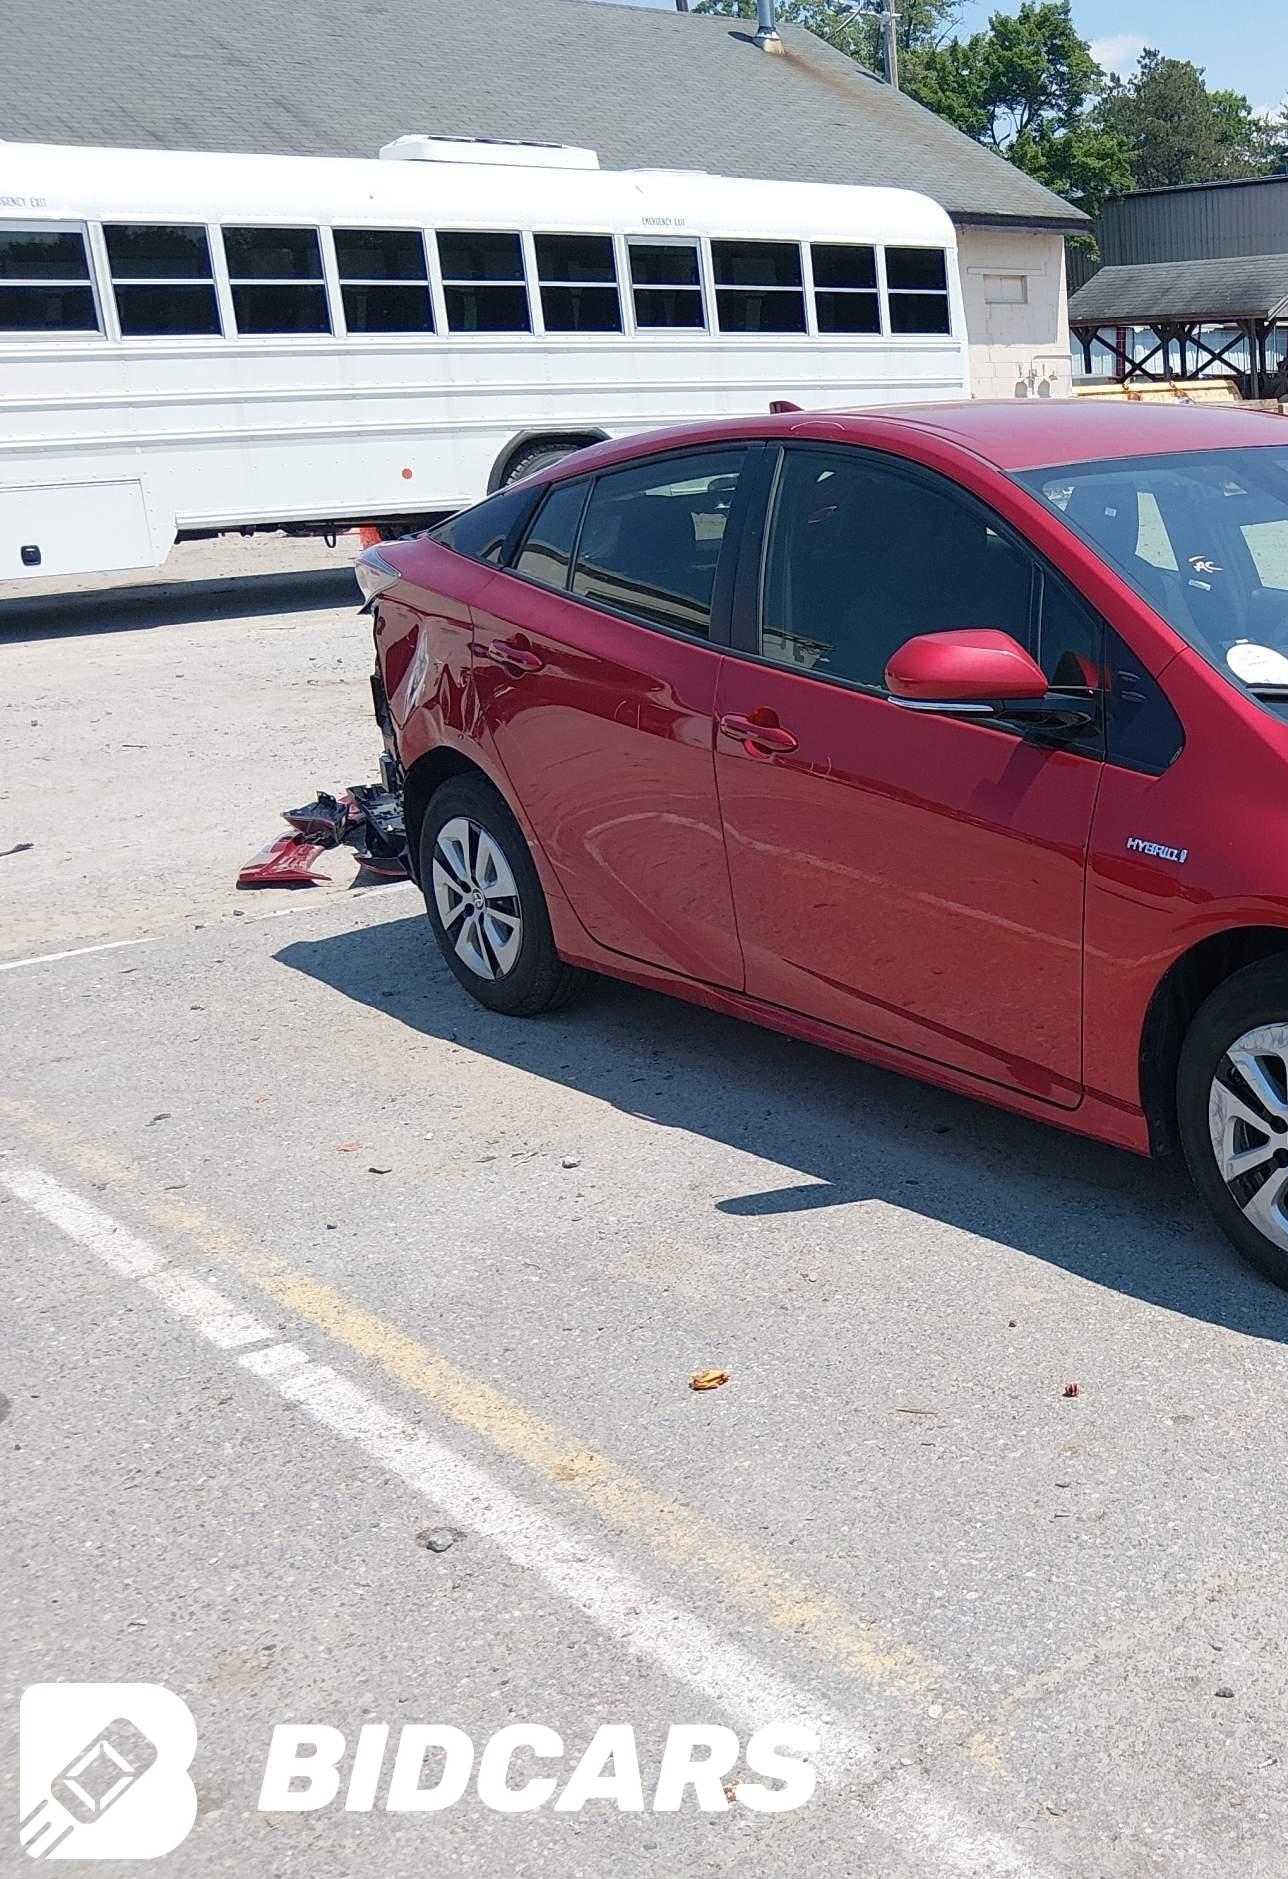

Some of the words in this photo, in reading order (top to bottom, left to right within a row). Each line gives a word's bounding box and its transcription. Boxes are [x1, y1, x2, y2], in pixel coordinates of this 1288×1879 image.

[30, 197, 47, 208] EXIT
[641, 216, 672, 226] EMERGENCY
[674, 217, 686, 227] EXIT
[1126, 837, 1179, 862] HYBRID
